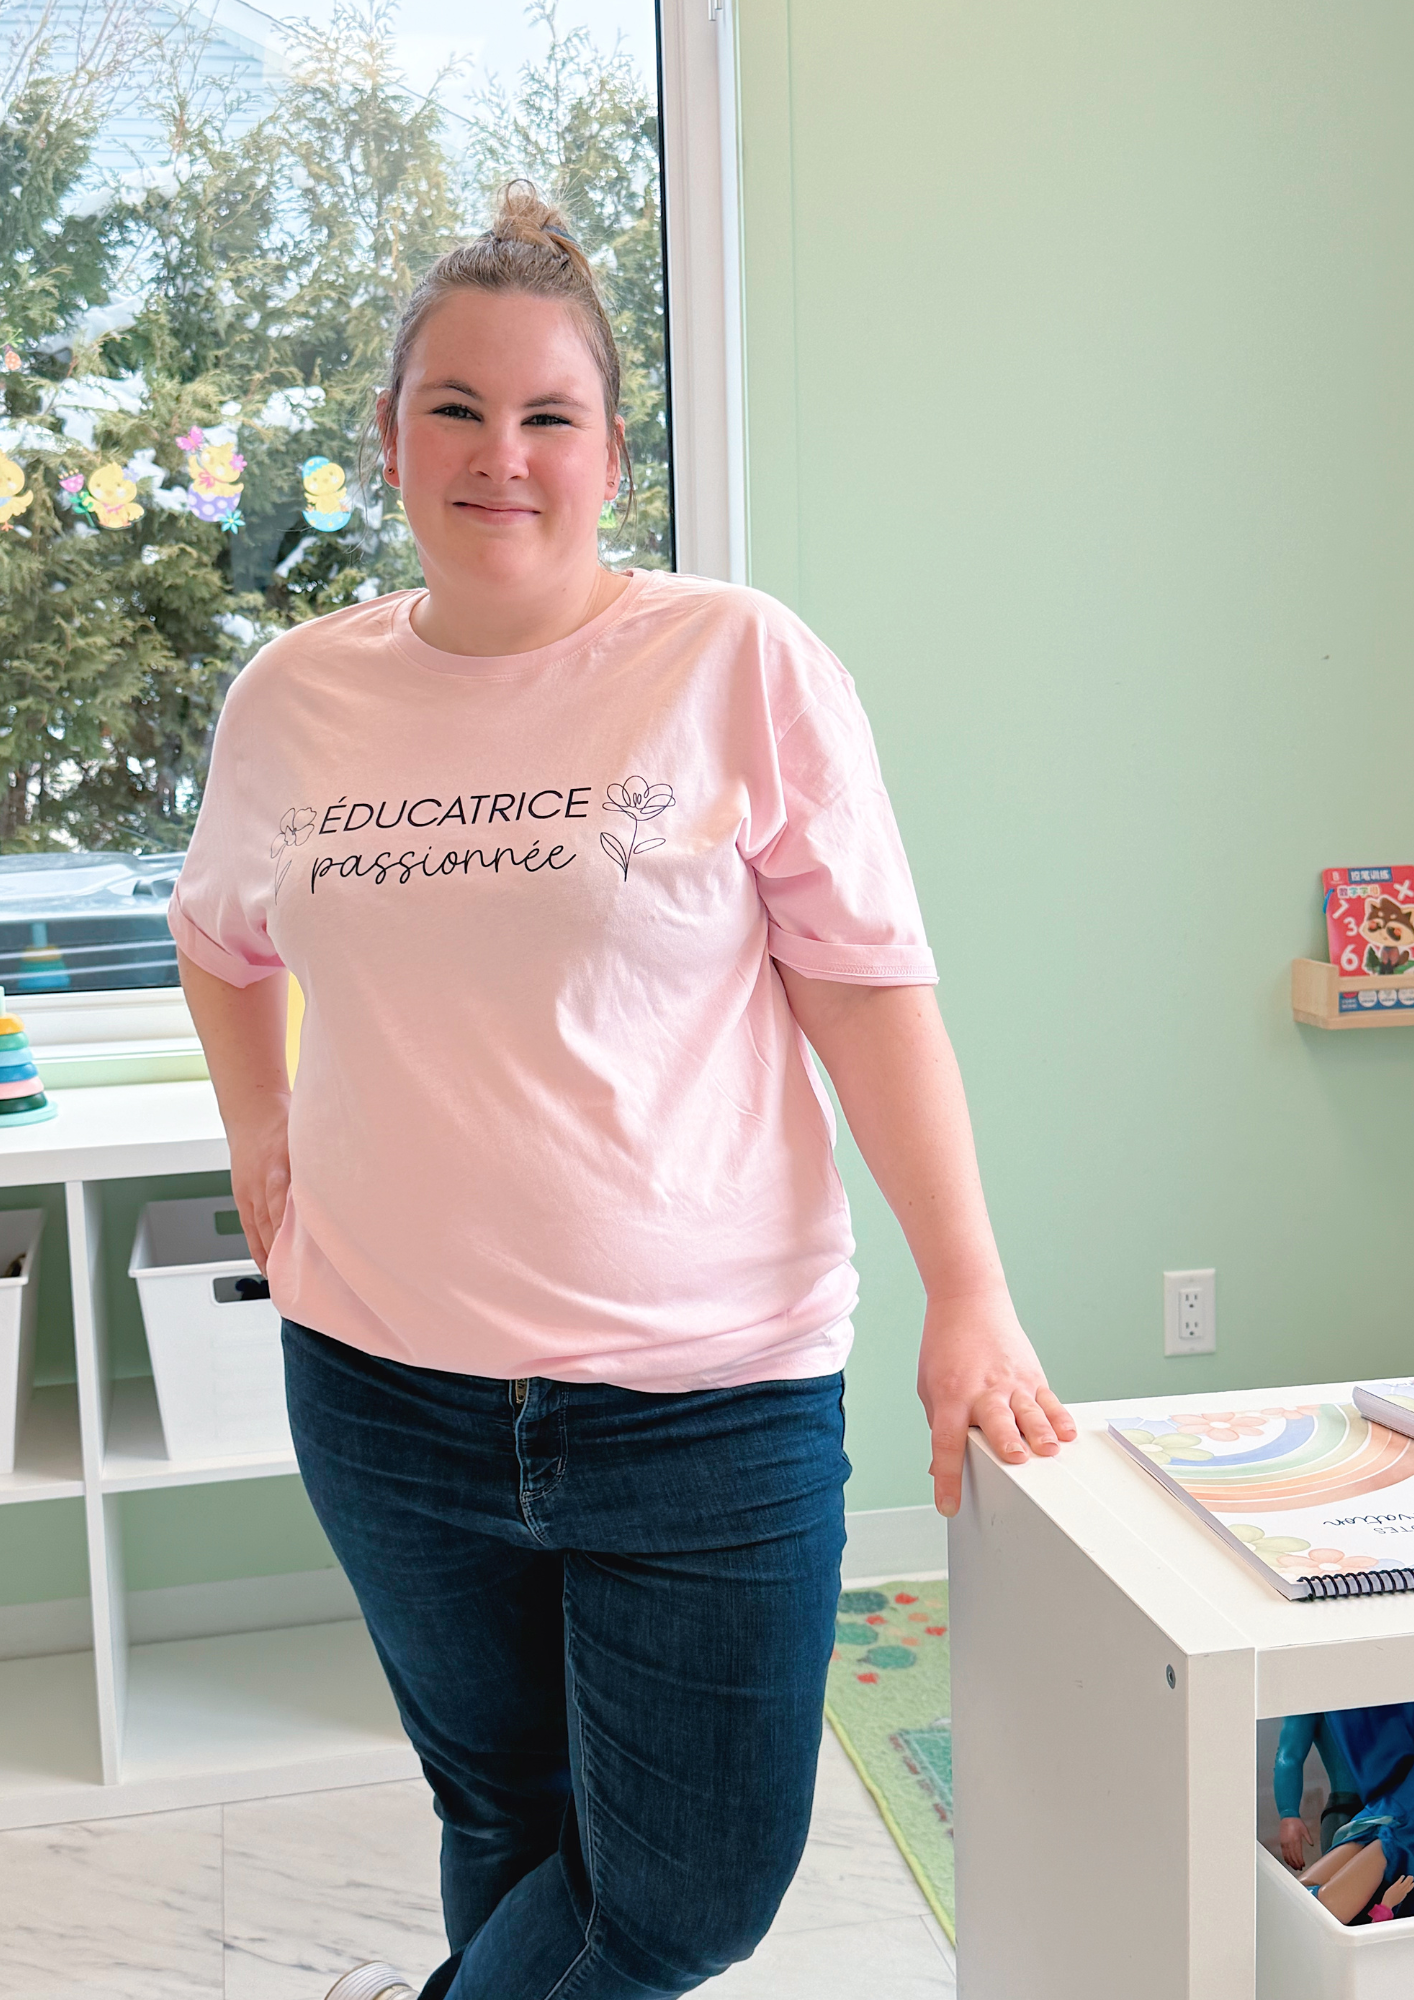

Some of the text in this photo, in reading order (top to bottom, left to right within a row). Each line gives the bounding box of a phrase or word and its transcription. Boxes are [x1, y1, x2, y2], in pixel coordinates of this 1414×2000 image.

[318, 786, 592, 835] ÉDUCATRICE
[310, 839, 577, 895] passionnée
[1343, 916, 1358, 937] 3
[1340, 943, 1359, 972] 6
[1323, 1513, 1414, 1526] vation
